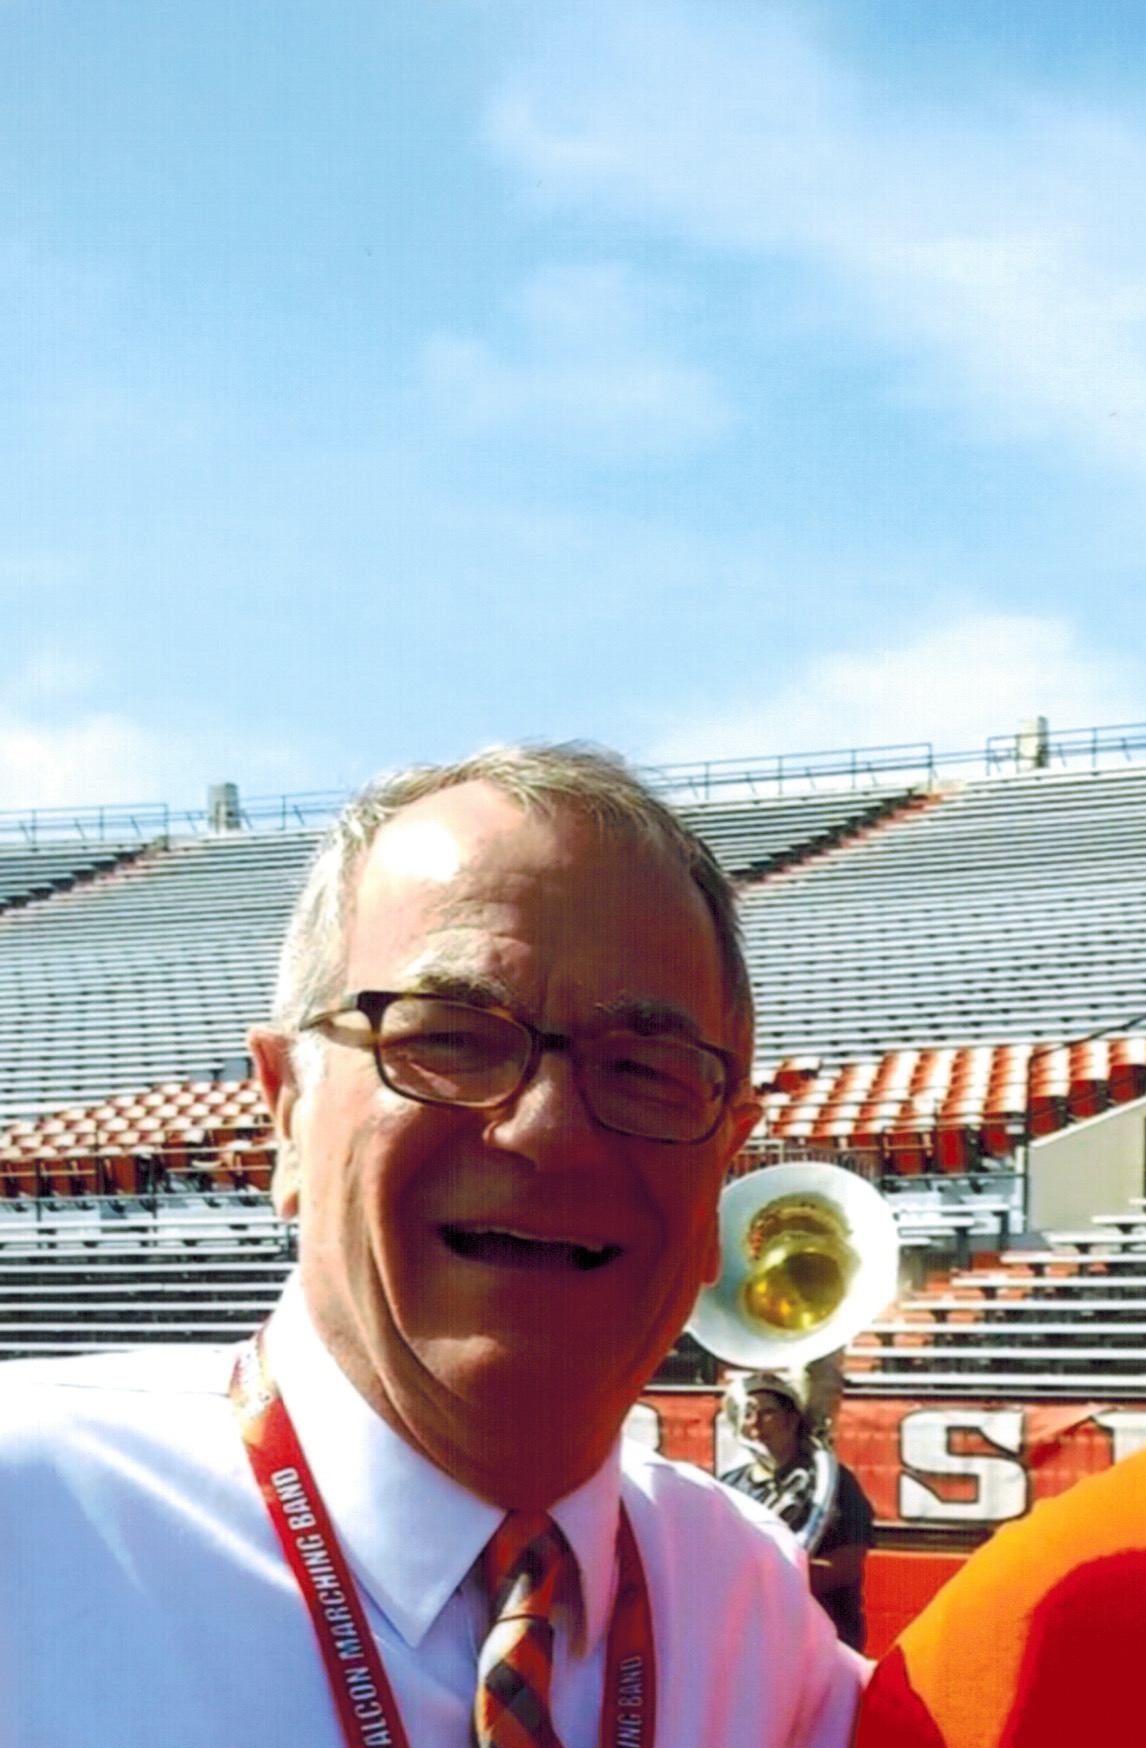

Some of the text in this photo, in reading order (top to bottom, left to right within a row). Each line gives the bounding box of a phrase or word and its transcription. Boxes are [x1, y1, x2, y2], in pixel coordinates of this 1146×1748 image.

[271, 1465, 317, 1532] BAND
[295, 1534, 365, 1665] MARCHING
[618, 1655, 643, 1708] BAND
